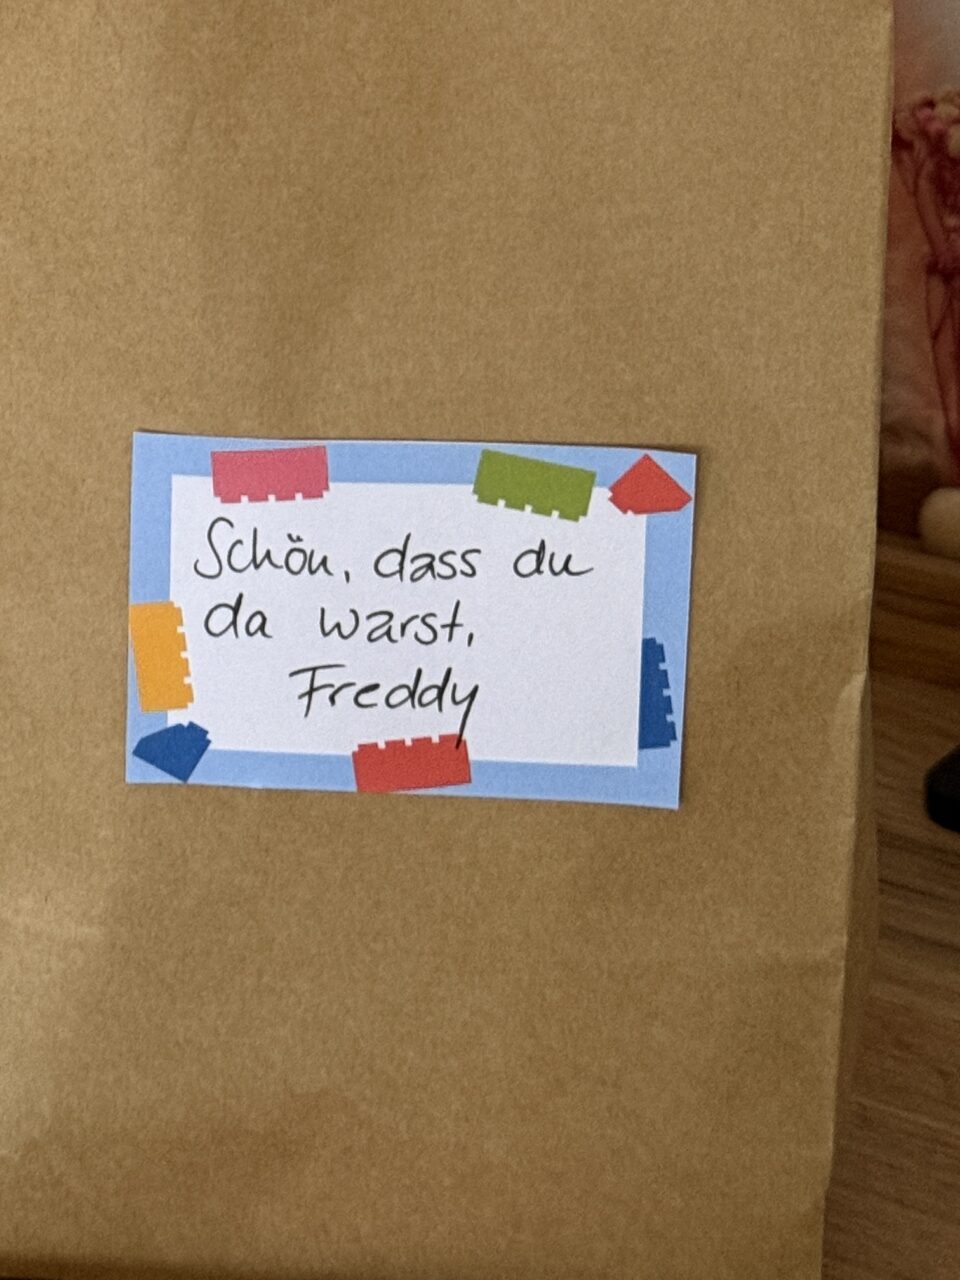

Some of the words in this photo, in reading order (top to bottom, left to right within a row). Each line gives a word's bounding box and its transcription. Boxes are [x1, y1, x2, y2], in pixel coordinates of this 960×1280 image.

[193, 516, 351, 585] Schön,
[373, 532, 482, 582] dass
[512, 538, 595, 578] du
[203, 592, 273, 640] da
[319, 599, 476, 648] warst,
[288, 662, 480, 750] Freddy
